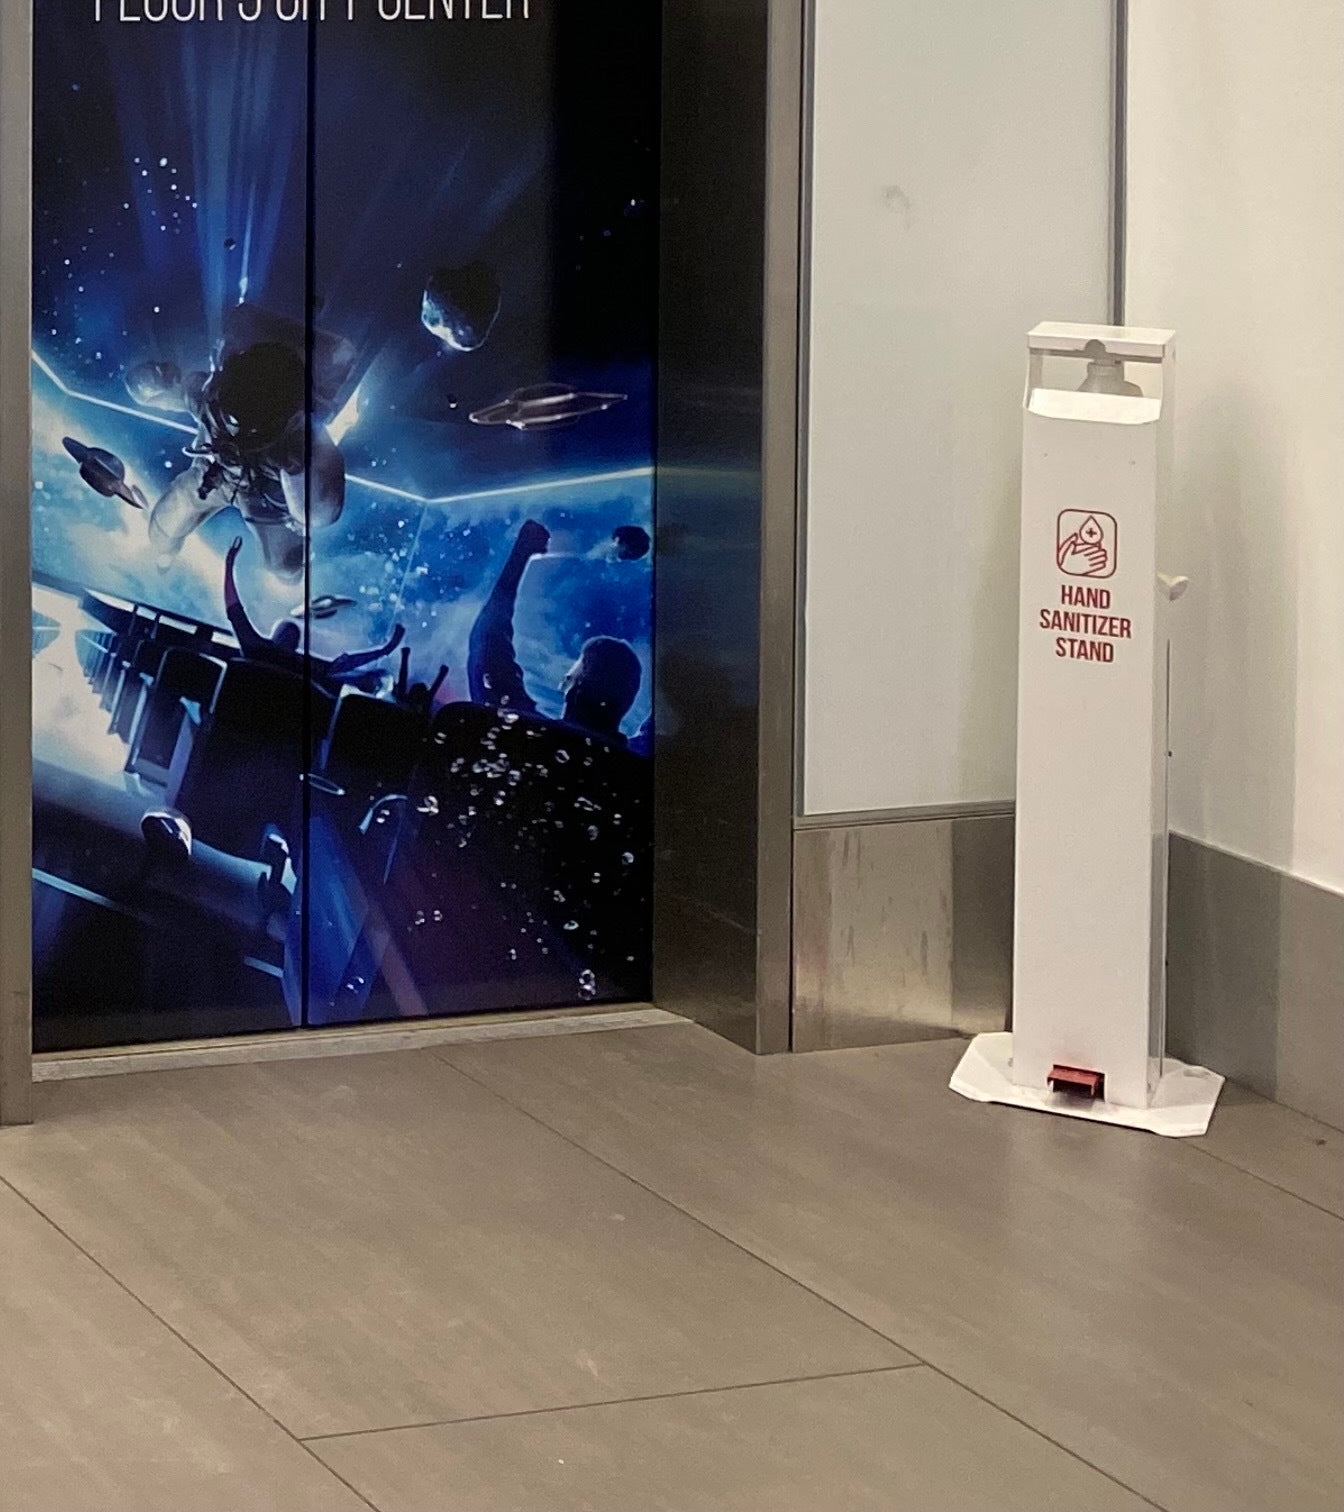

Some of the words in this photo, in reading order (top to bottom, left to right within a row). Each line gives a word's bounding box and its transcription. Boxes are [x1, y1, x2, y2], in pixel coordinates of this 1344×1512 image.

[1060, 584, 1111, 610] HAND
[1039, 608, 1132, 639] SANITIZER
[1054, 636, 1115, 663] STAND
